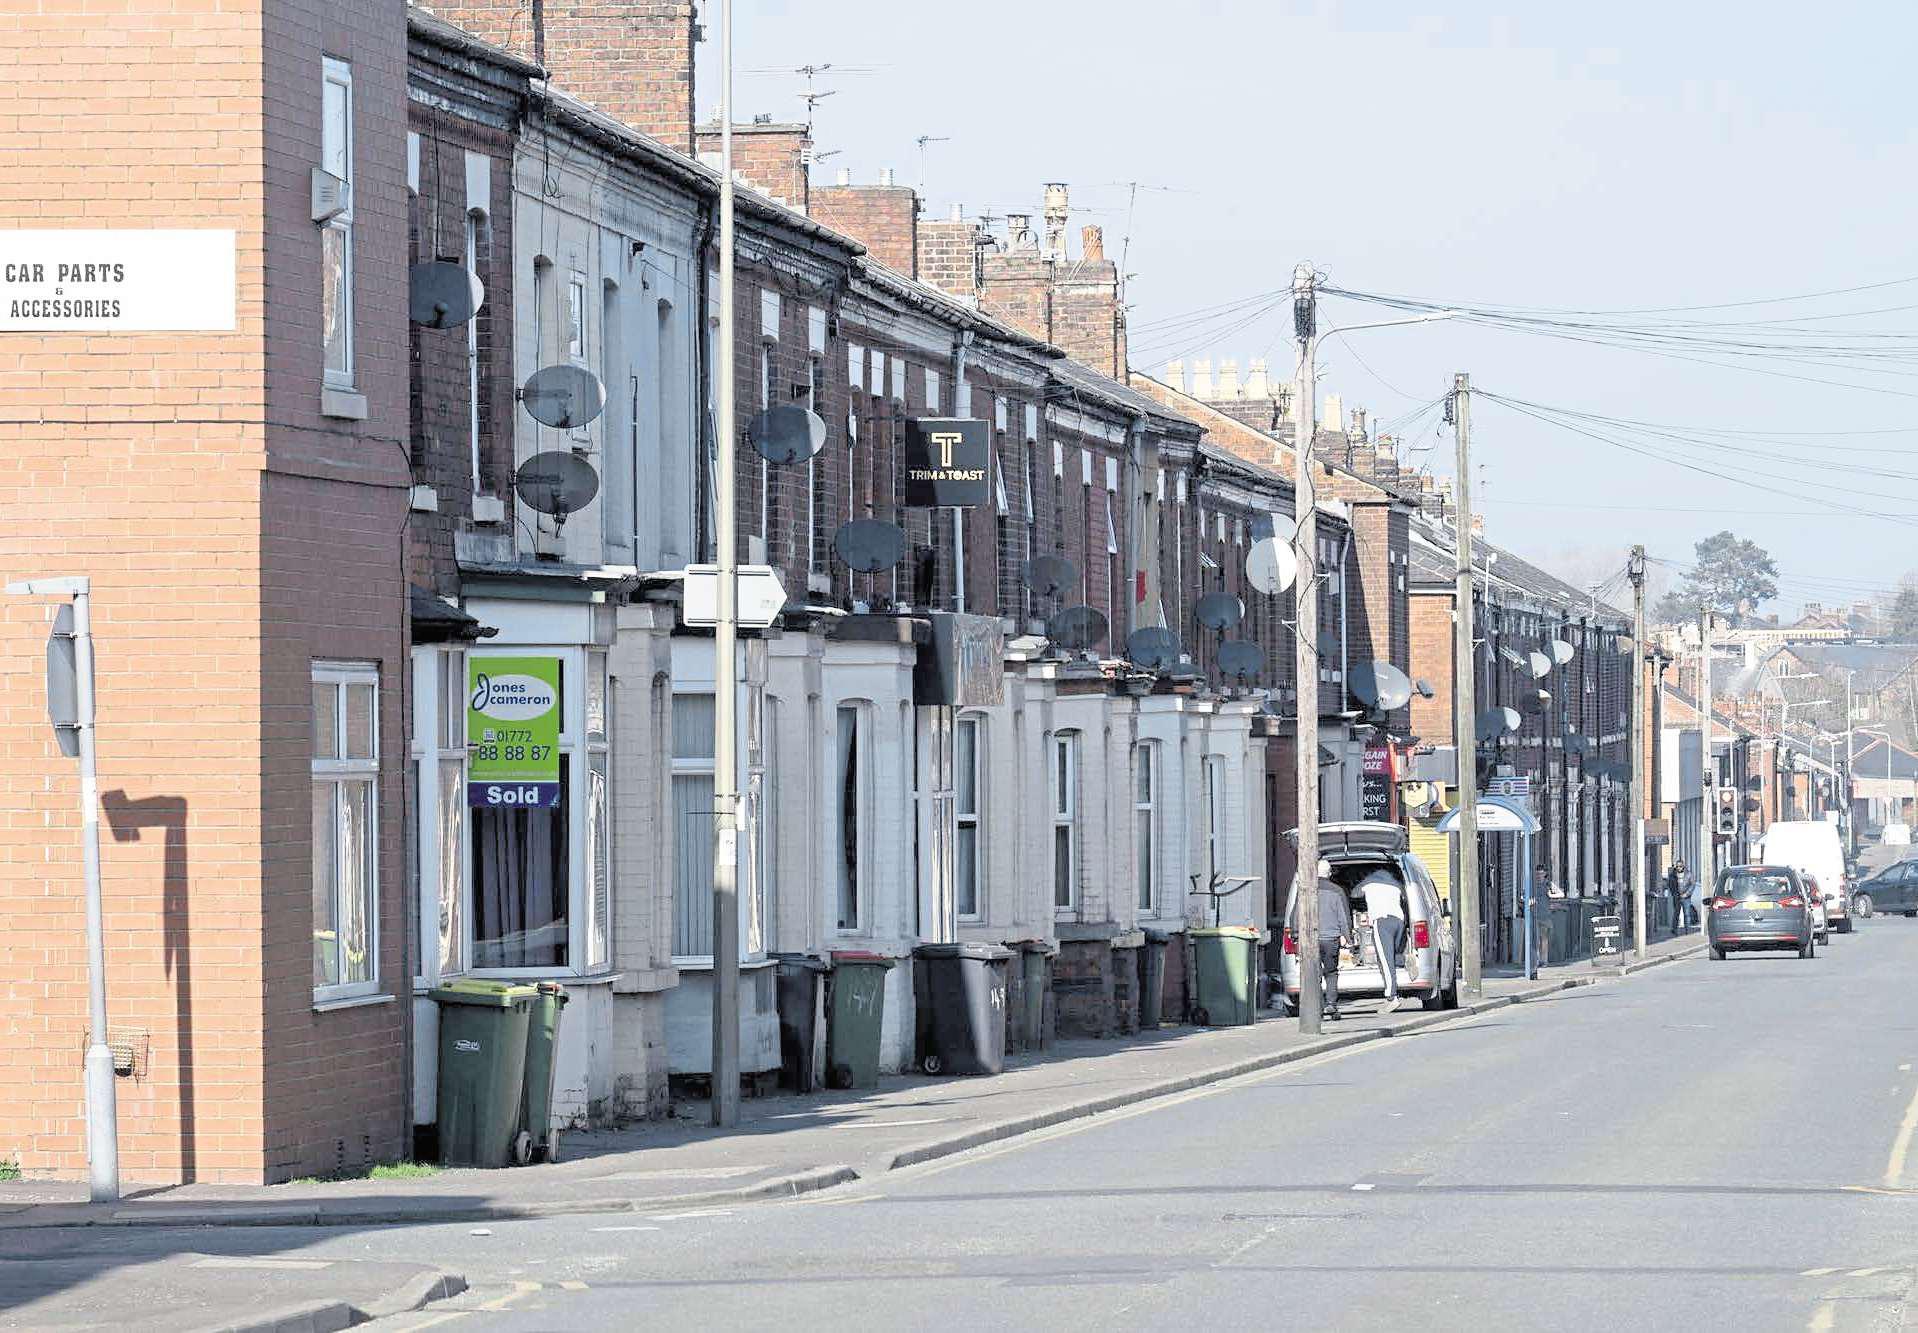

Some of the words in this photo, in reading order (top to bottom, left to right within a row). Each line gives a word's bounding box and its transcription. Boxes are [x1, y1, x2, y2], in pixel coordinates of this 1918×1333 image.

[5, 263, 44, 282] CAR
[58, 263, 125, 282] PARTS
[55, 287, 64, 296] &
[10, 299, 121, 318] ACCESSORIES
[909, 470, 938, 480] TRIM
[939, 470, 946, 480] &
[946, 470, 985, 480] TOAST
[472, 672, 526, 711] Jones
[490, 694, 551, 705] cameron
[496, 729, 532, 743] 01772
[504, 745, 525, 761] 88
[1363, 750, 1388, 760] GAIN
[1363, 761, 1383, 770] OZE
[486, 785, 539, 804] Sold
[1363, 794, 1387, 803] KING
[1363, 806, 1380, 816] RST
